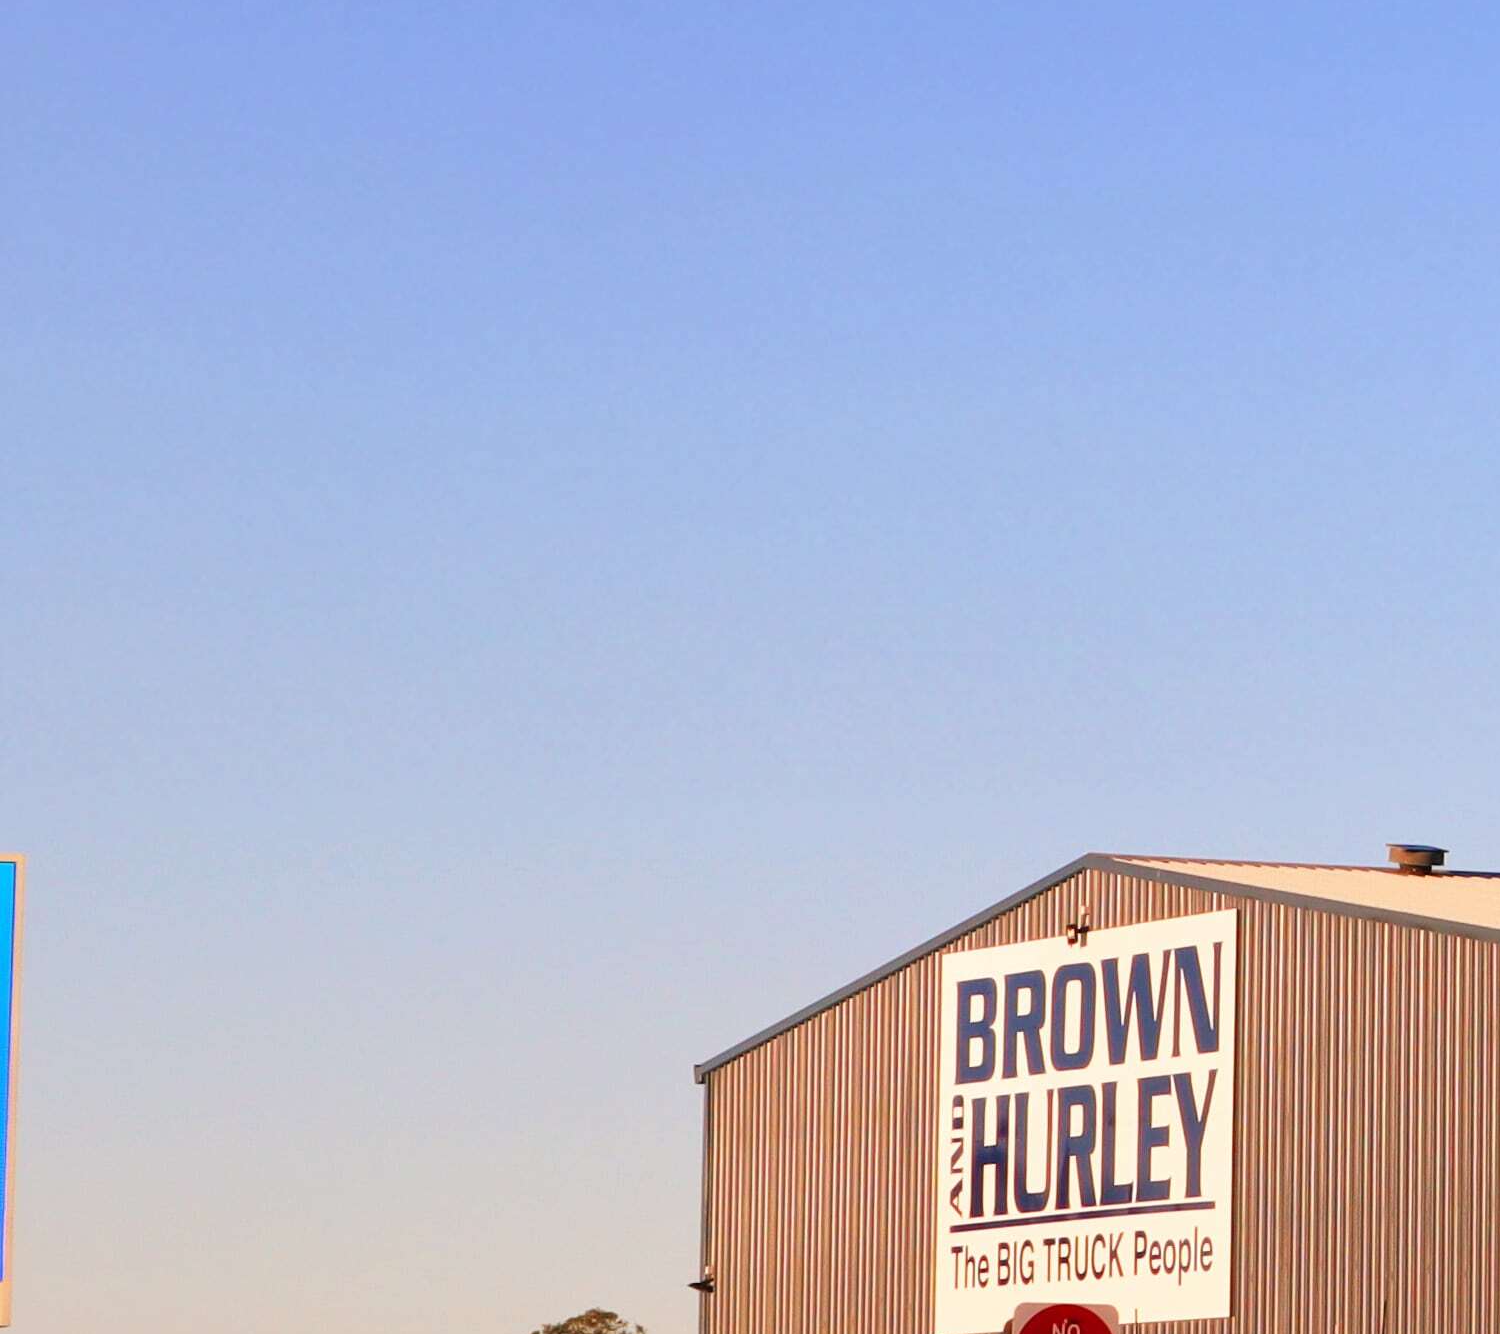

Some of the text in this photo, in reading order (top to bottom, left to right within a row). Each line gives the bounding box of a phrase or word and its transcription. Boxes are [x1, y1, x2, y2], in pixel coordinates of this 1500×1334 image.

[954, 941, 1222, 1085] BROWN
[950, 1094, 965, 1218] AND
[970, 1069, 1218, 1218] HURLEY
[951, 1225, 1214, 1289] The BIG TRUCK People
